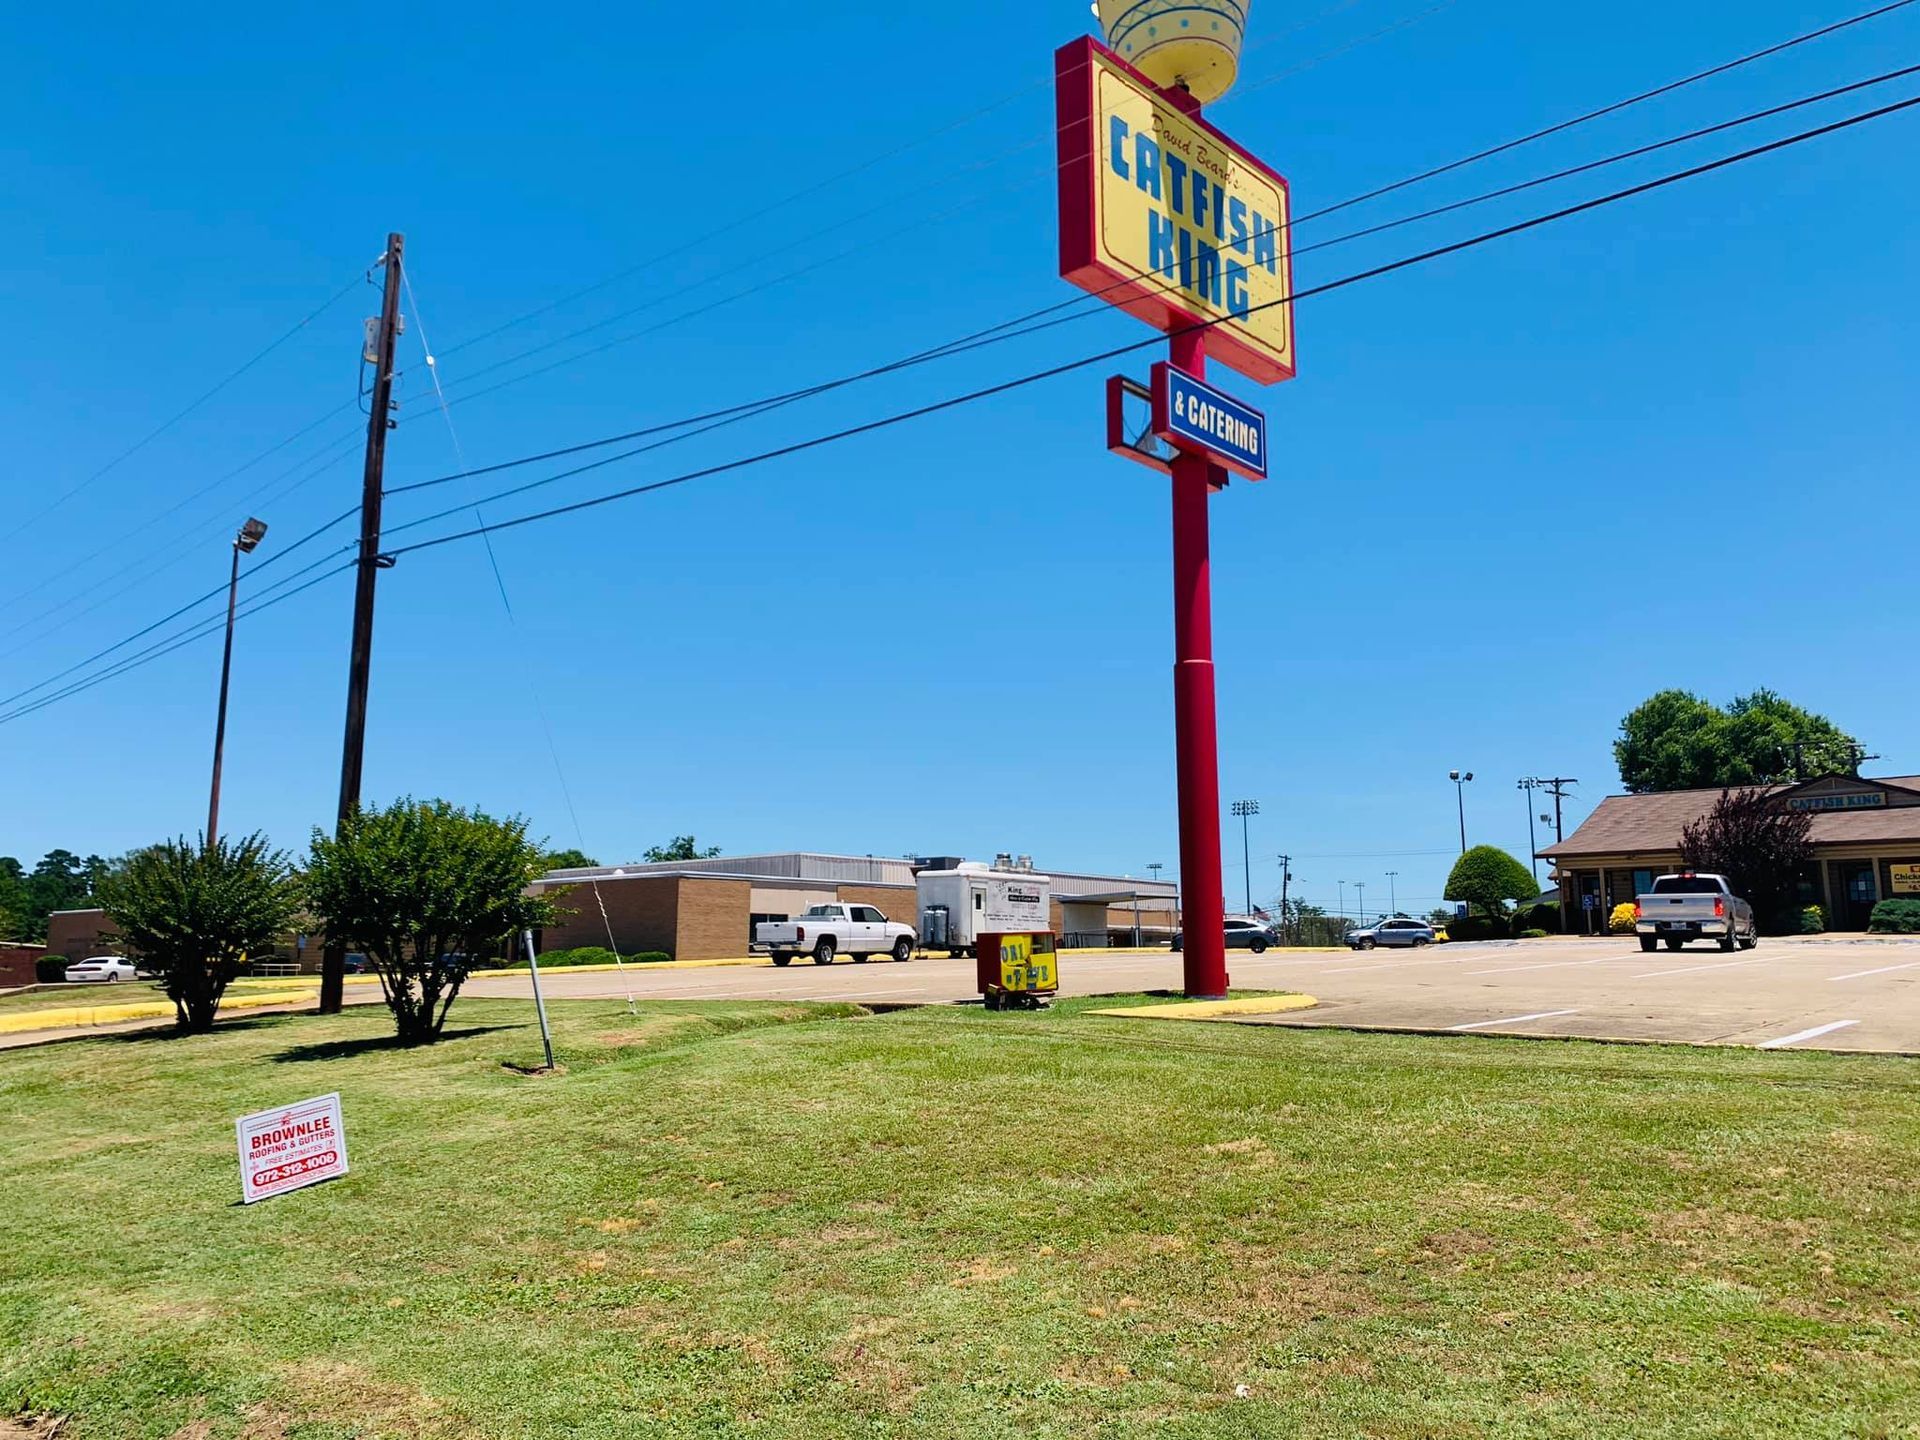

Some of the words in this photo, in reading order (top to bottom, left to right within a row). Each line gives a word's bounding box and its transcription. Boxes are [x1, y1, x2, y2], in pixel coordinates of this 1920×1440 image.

[1151, 113, 1191, 155] David
[1110, 114, 1276, 276] CATFISH
[1148, 207, 1249, 323] KING
[1175, 390, 1184, 416] &
[1188, 395, 1258, 456] CATERING
[1790, 797, 1843, 810] CATFISH
[1847, 794, 1880, 806] KING
[249, 1142, 288, 1160] ROOFING
[289, 1140, 296, 1149] &
[298, 1129, 335, 1146] GUTTERS
[251, 1116, 330, 1149] BROWNLEE
[255, 1152, 336, 1185] 972-312-1008
[285, 1143, 323, 1161] ESTIMATES
